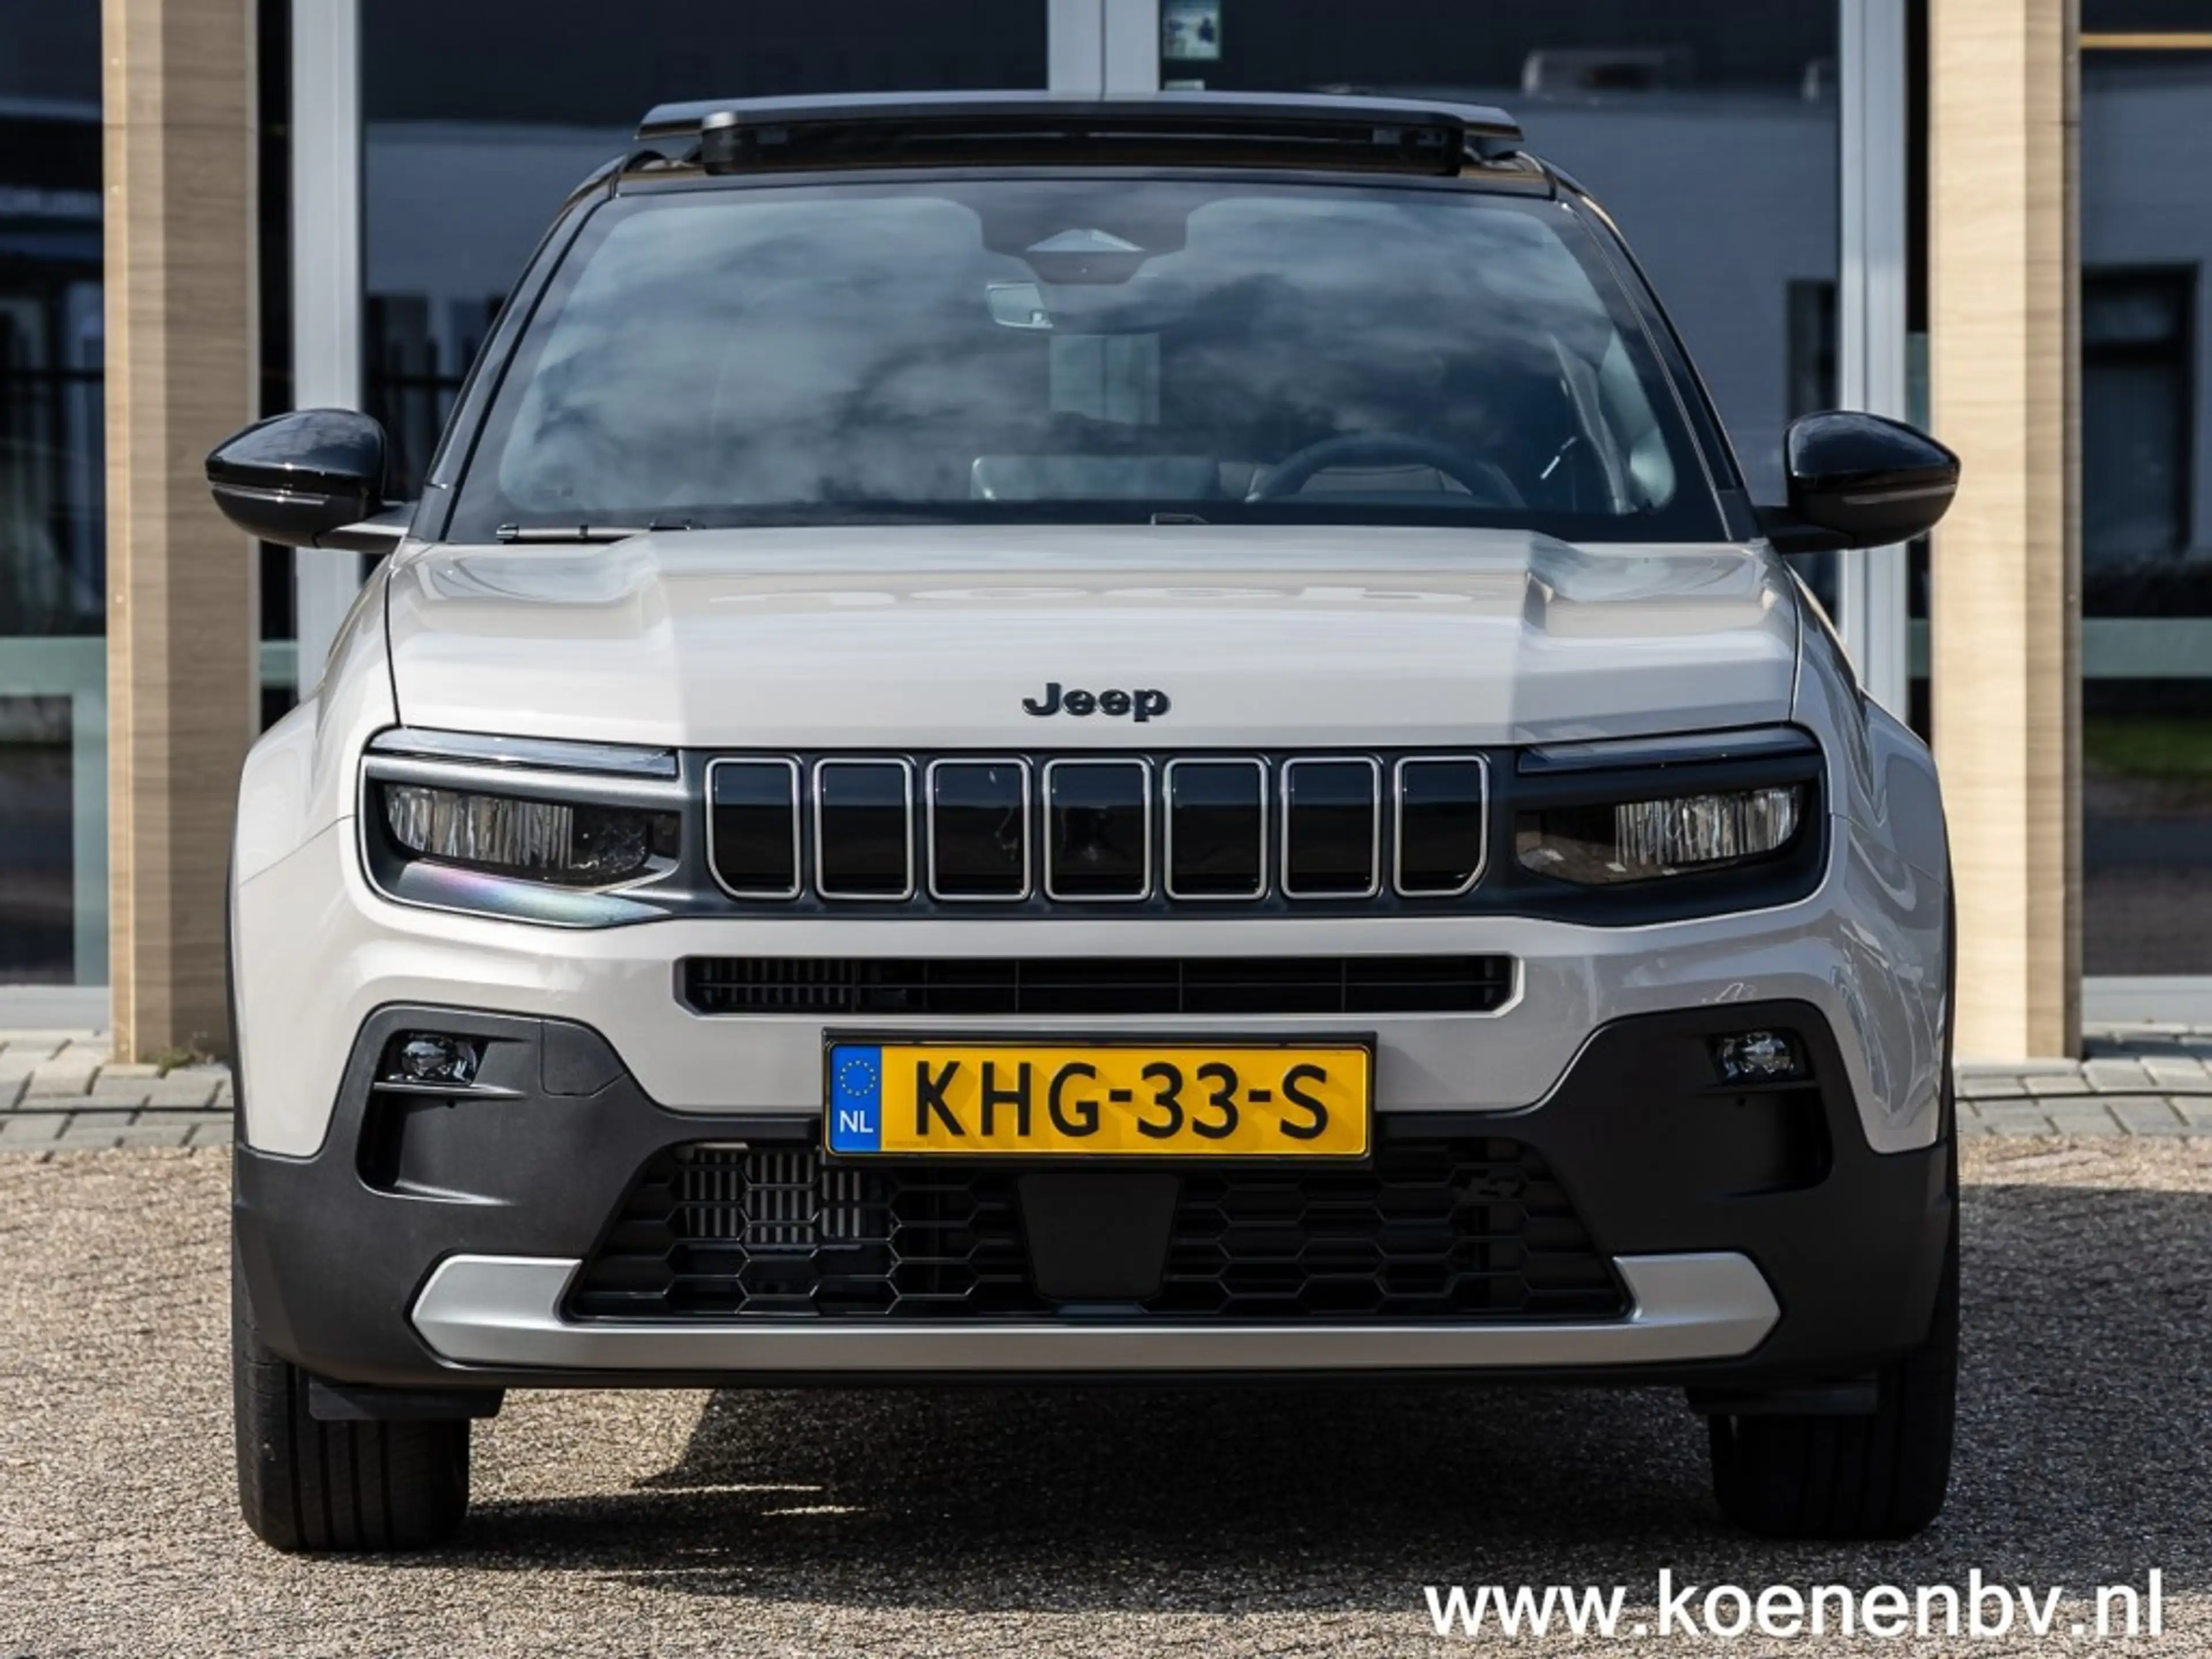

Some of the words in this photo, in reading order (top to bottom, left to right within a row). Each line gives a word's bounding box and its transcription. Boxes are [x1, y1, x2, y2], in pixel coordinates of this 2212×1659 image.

[1022, 682, 1171, 722] Jeep
[915, 1060, 1330, 1139] KHG-33-S
[840, 1111, 873, 1133] NL
